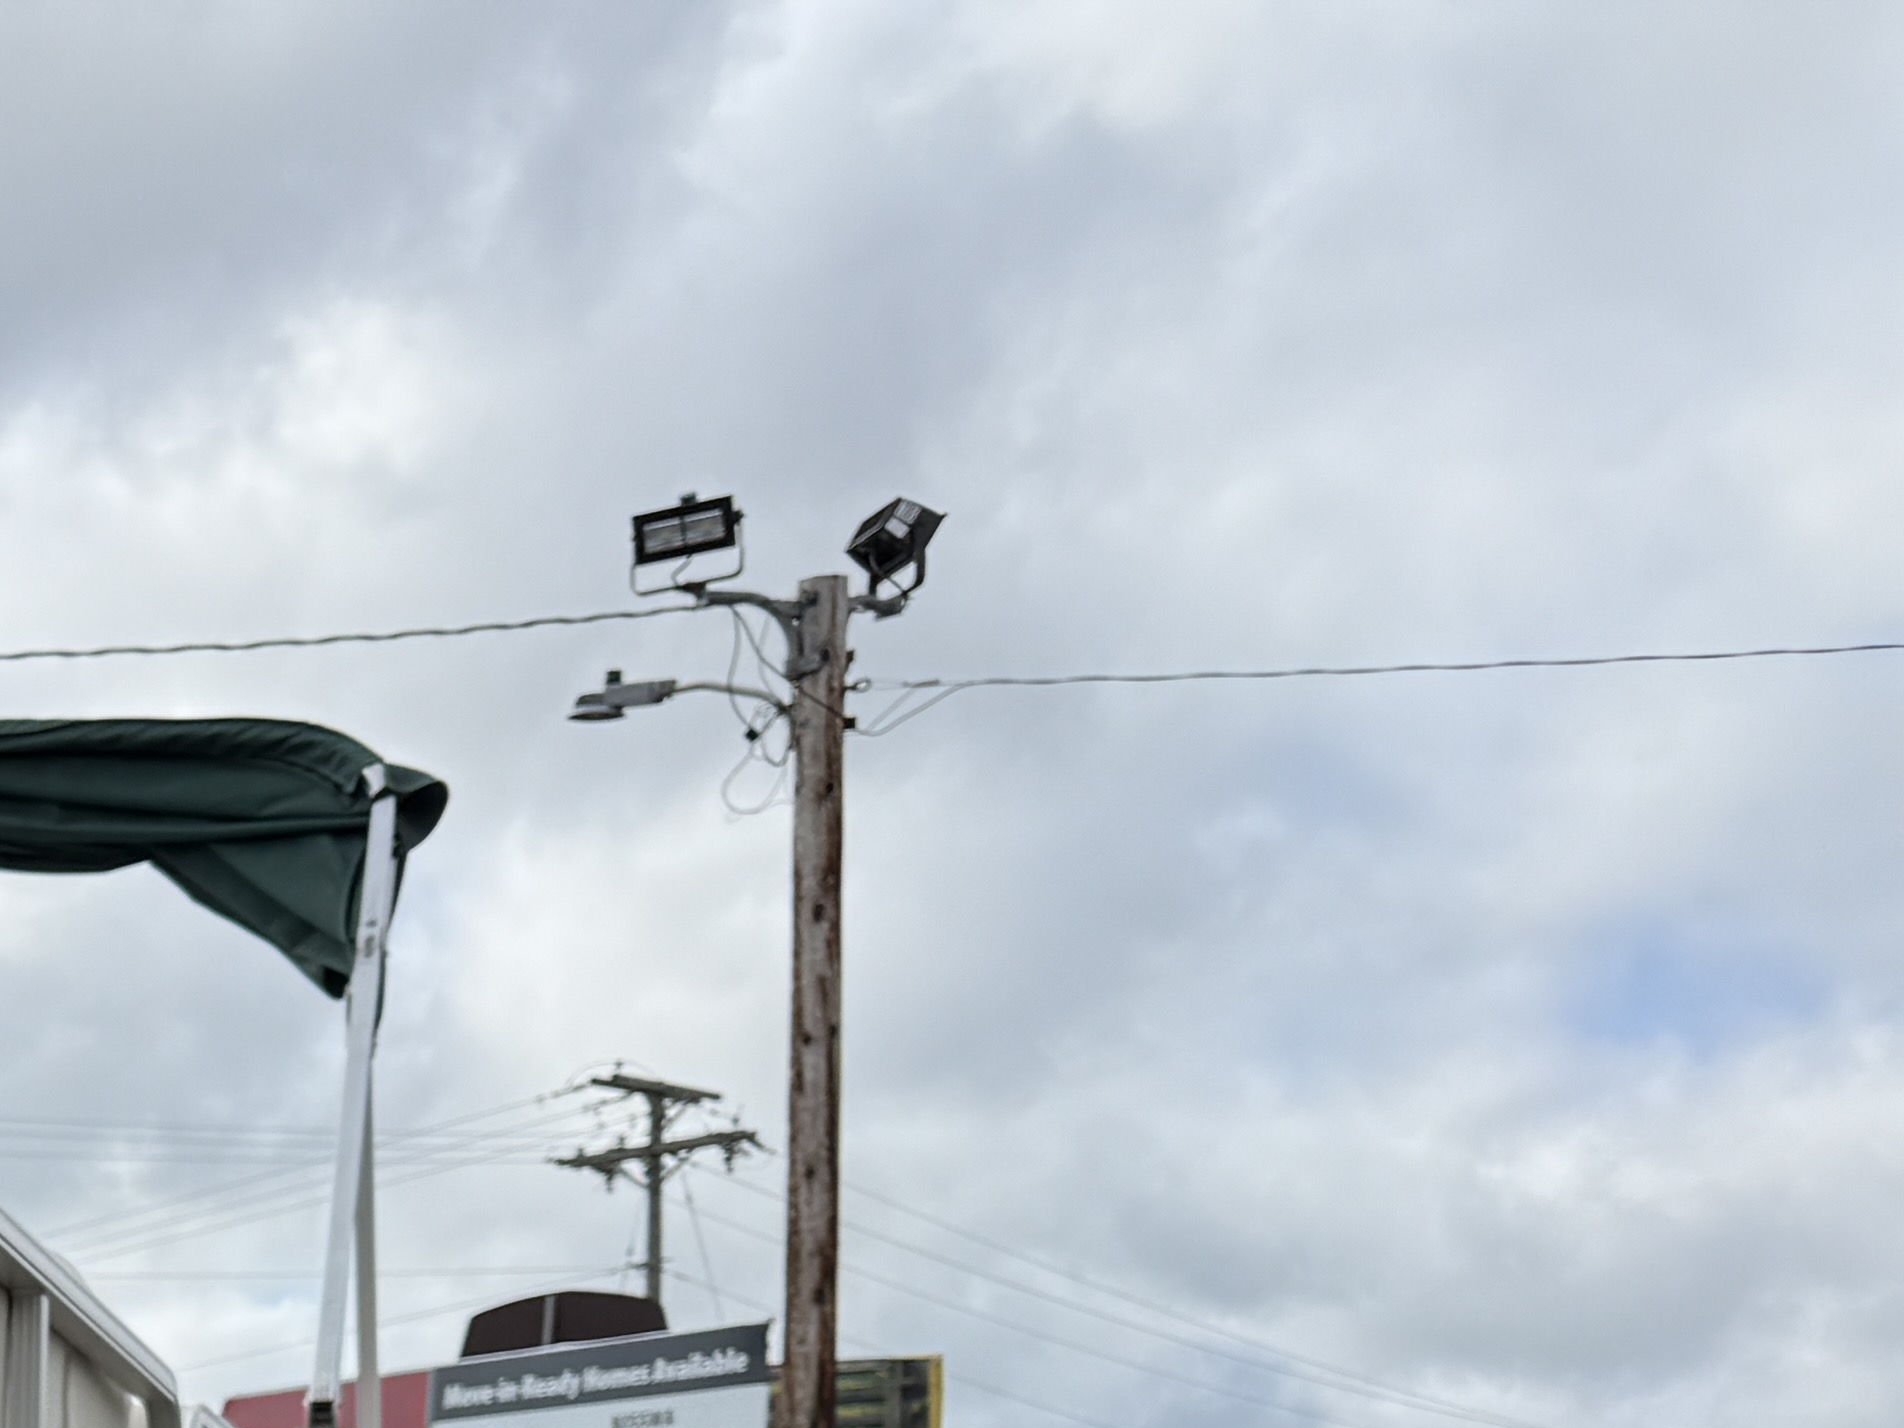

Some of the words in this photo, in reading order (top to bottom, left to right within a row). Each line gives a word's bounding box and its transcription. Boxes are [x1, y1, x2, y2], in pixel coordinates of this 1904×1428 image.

[520, 1368, 580, 1400] Ready
[583, 1364, 650, 1393] Homes
[651, 1347, 749, 1383] Available
